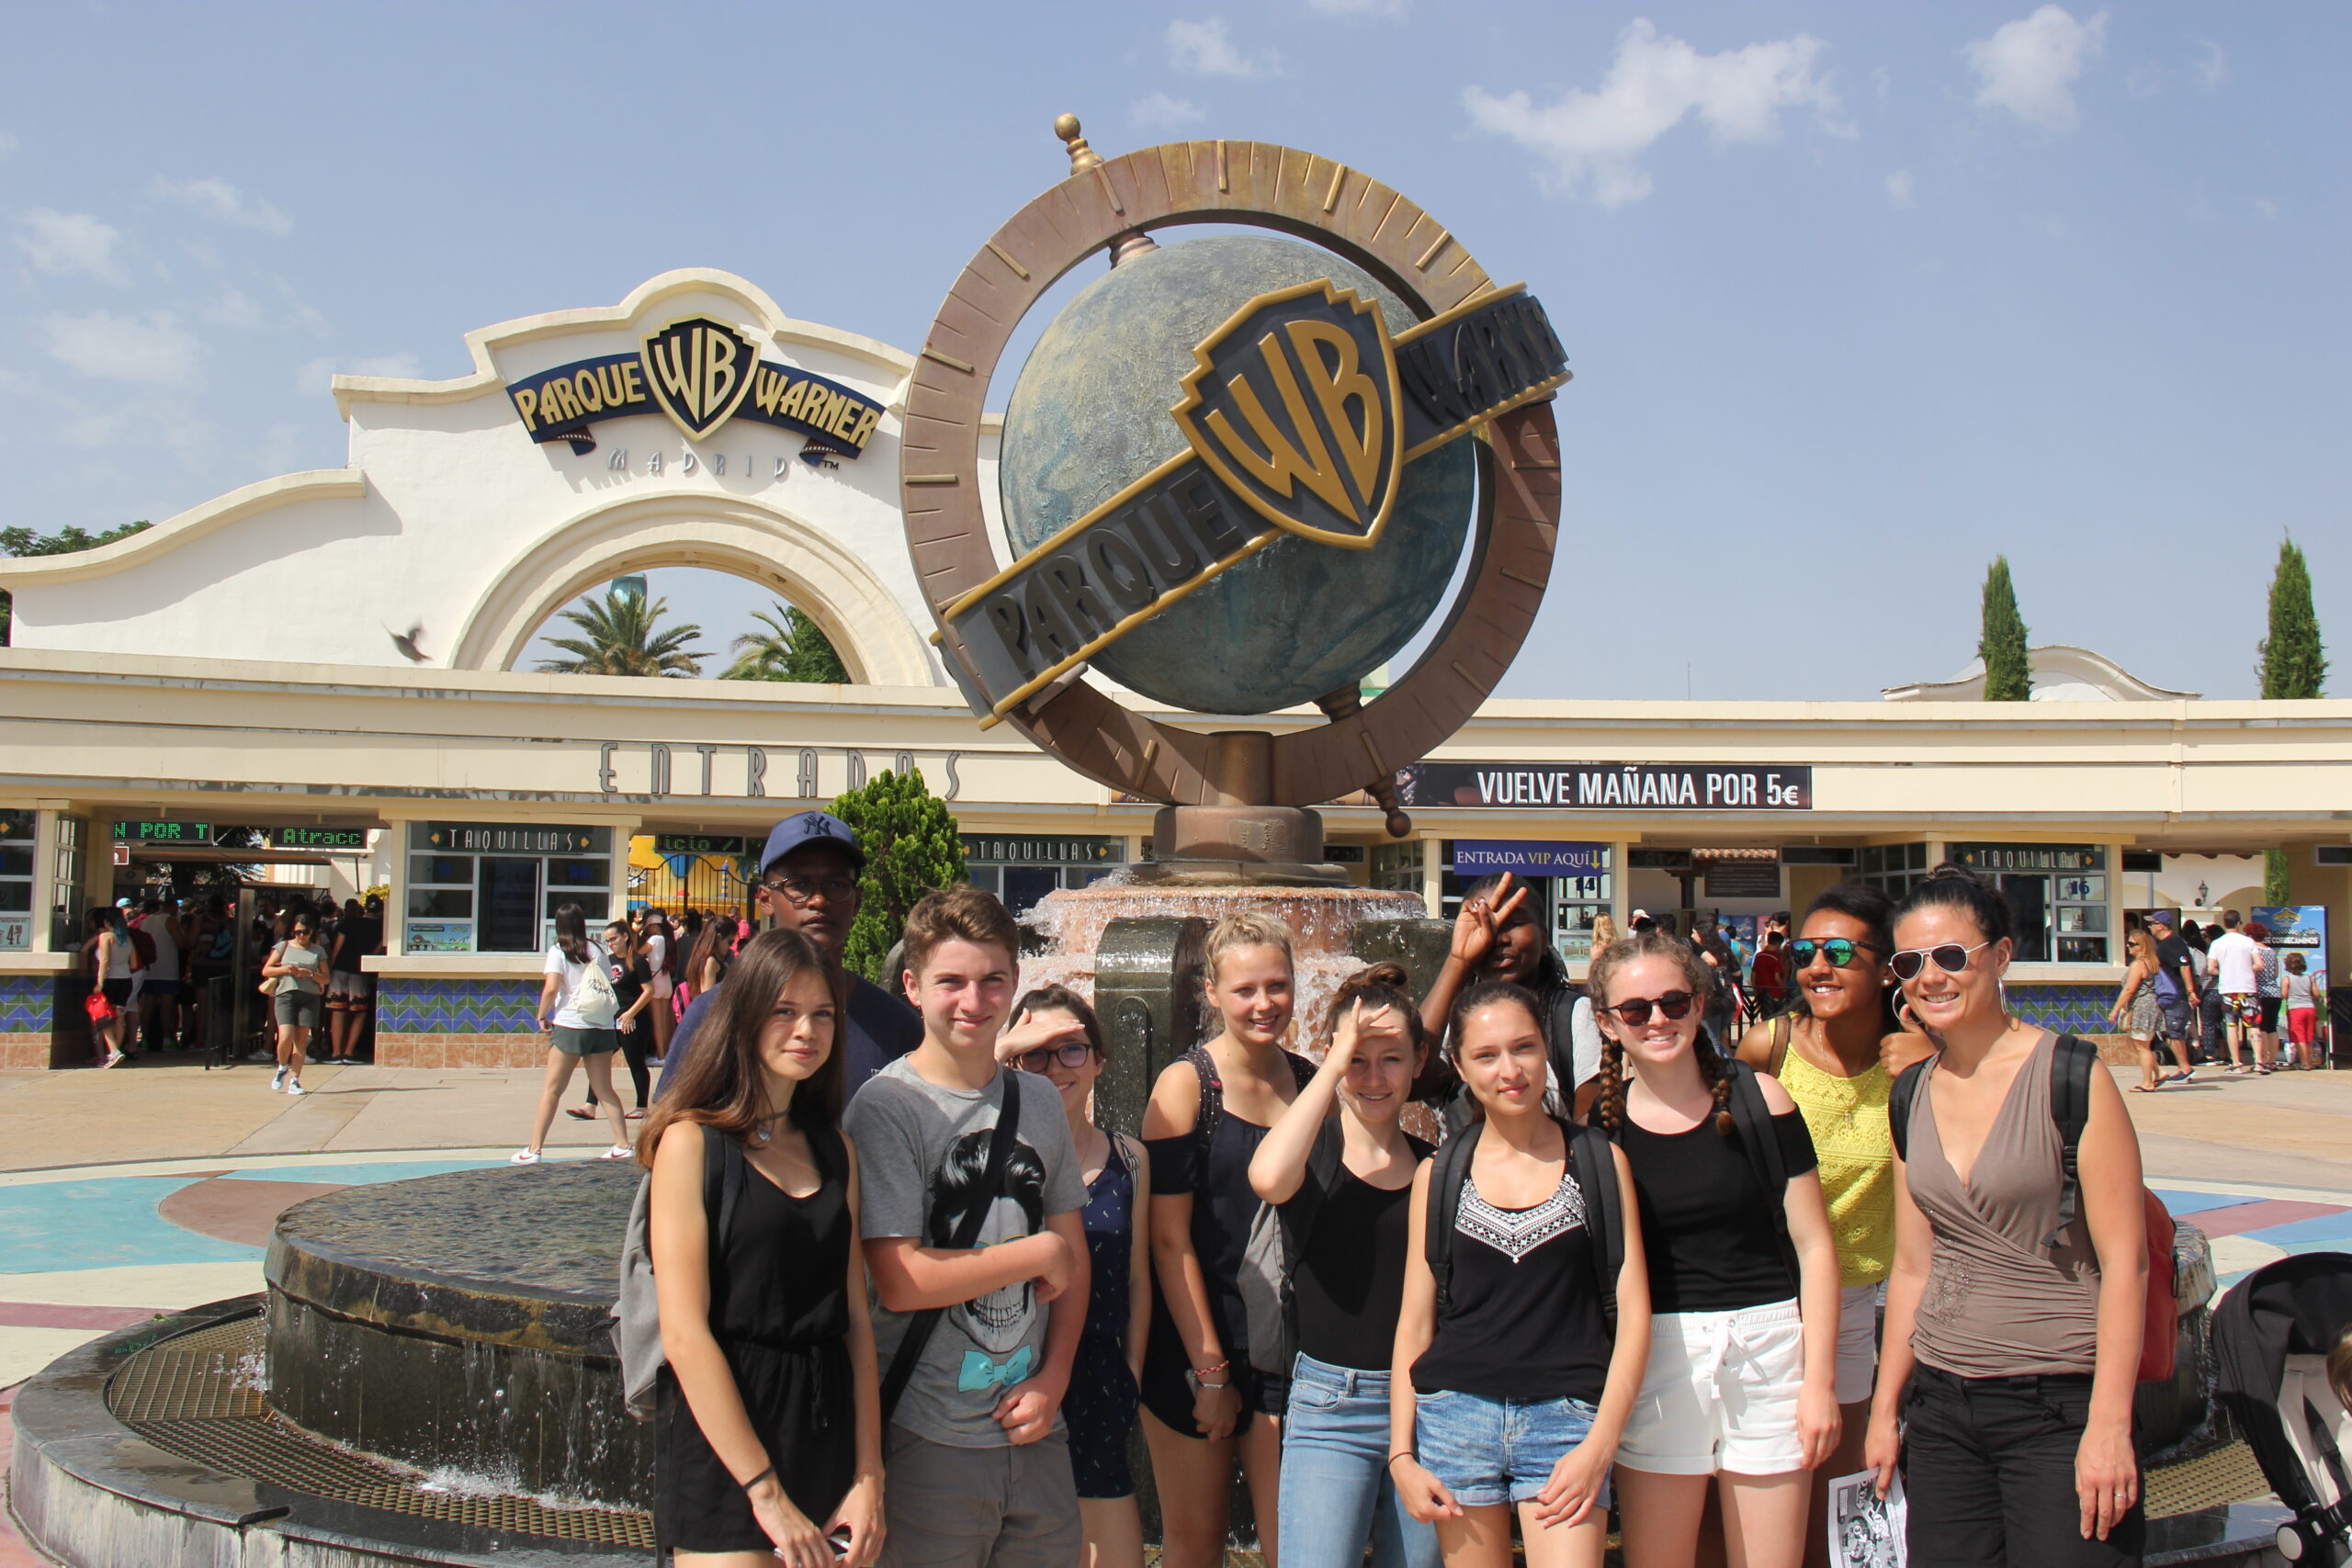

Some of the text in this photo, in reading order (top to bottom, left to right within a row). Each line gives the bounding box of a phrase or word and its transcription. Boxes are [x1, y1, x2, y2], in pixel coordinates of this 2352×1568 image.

[514, 327, 881, 449] PARQUE WB WARNER
[607, 448, 787, 479] MADRID
[984, 467, 1247, 682] PARQUE
[1204, 319, 1383, 525] WB
[1476, 766, 1799, 807] VUELVE MAÑANA POR 5€
[141, 822, 181, 839] POR
[196, 823, 208, 840] T
[283, 828, 361, 844] Atracc
[803, 815, 831, 836] NY
[449, 829, 572, 852] TAQUILLAS
[978, 840, 1092, 863] TAQUILLAS
[1456, 850, 1589, 868] ENTRADA VIP AQUÍ
[1980, 850, 2081, 872] TAQUILLAS
[1575, 876, 1596, 891] 14
[2071, 880, 2090, 895] 16
